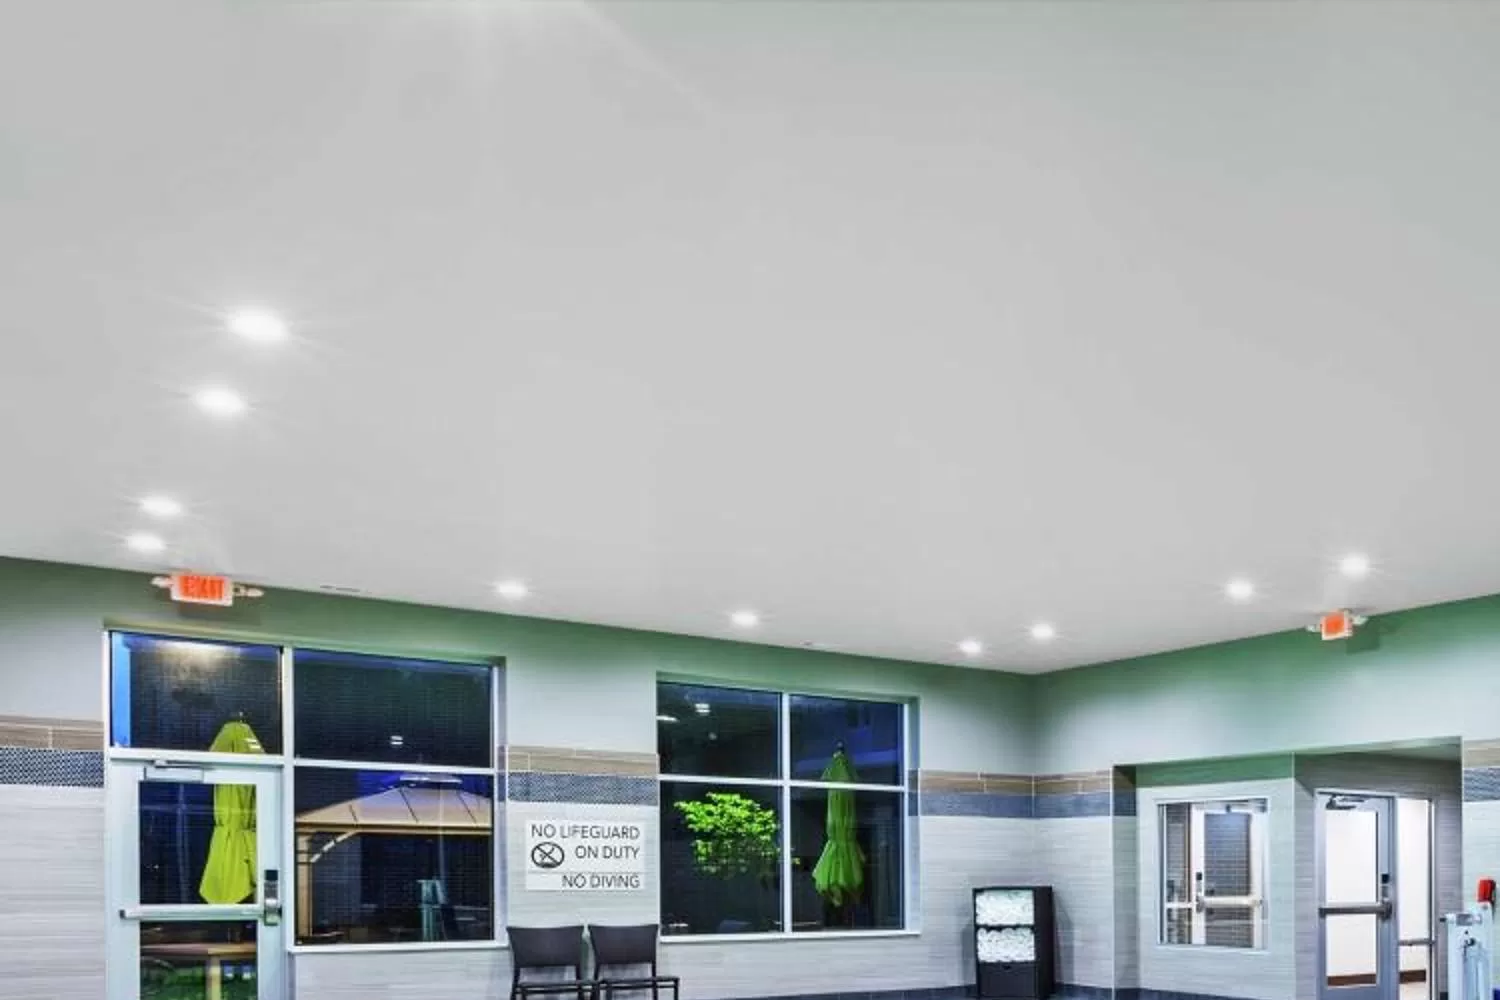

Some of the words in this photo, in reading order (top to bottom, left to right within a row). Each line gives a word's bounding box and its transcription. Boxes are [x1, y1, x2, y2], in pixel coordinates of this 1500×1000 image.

[531, 824, 556, 838] NO
[560, 825, 640, 840] LIFEGUARD
[575, 845, 599, 859] ON
[602, 846, 640, 859] DUTY
[562, 874, 587, 889] NO
[590, 875, 640, 889] DIVING
